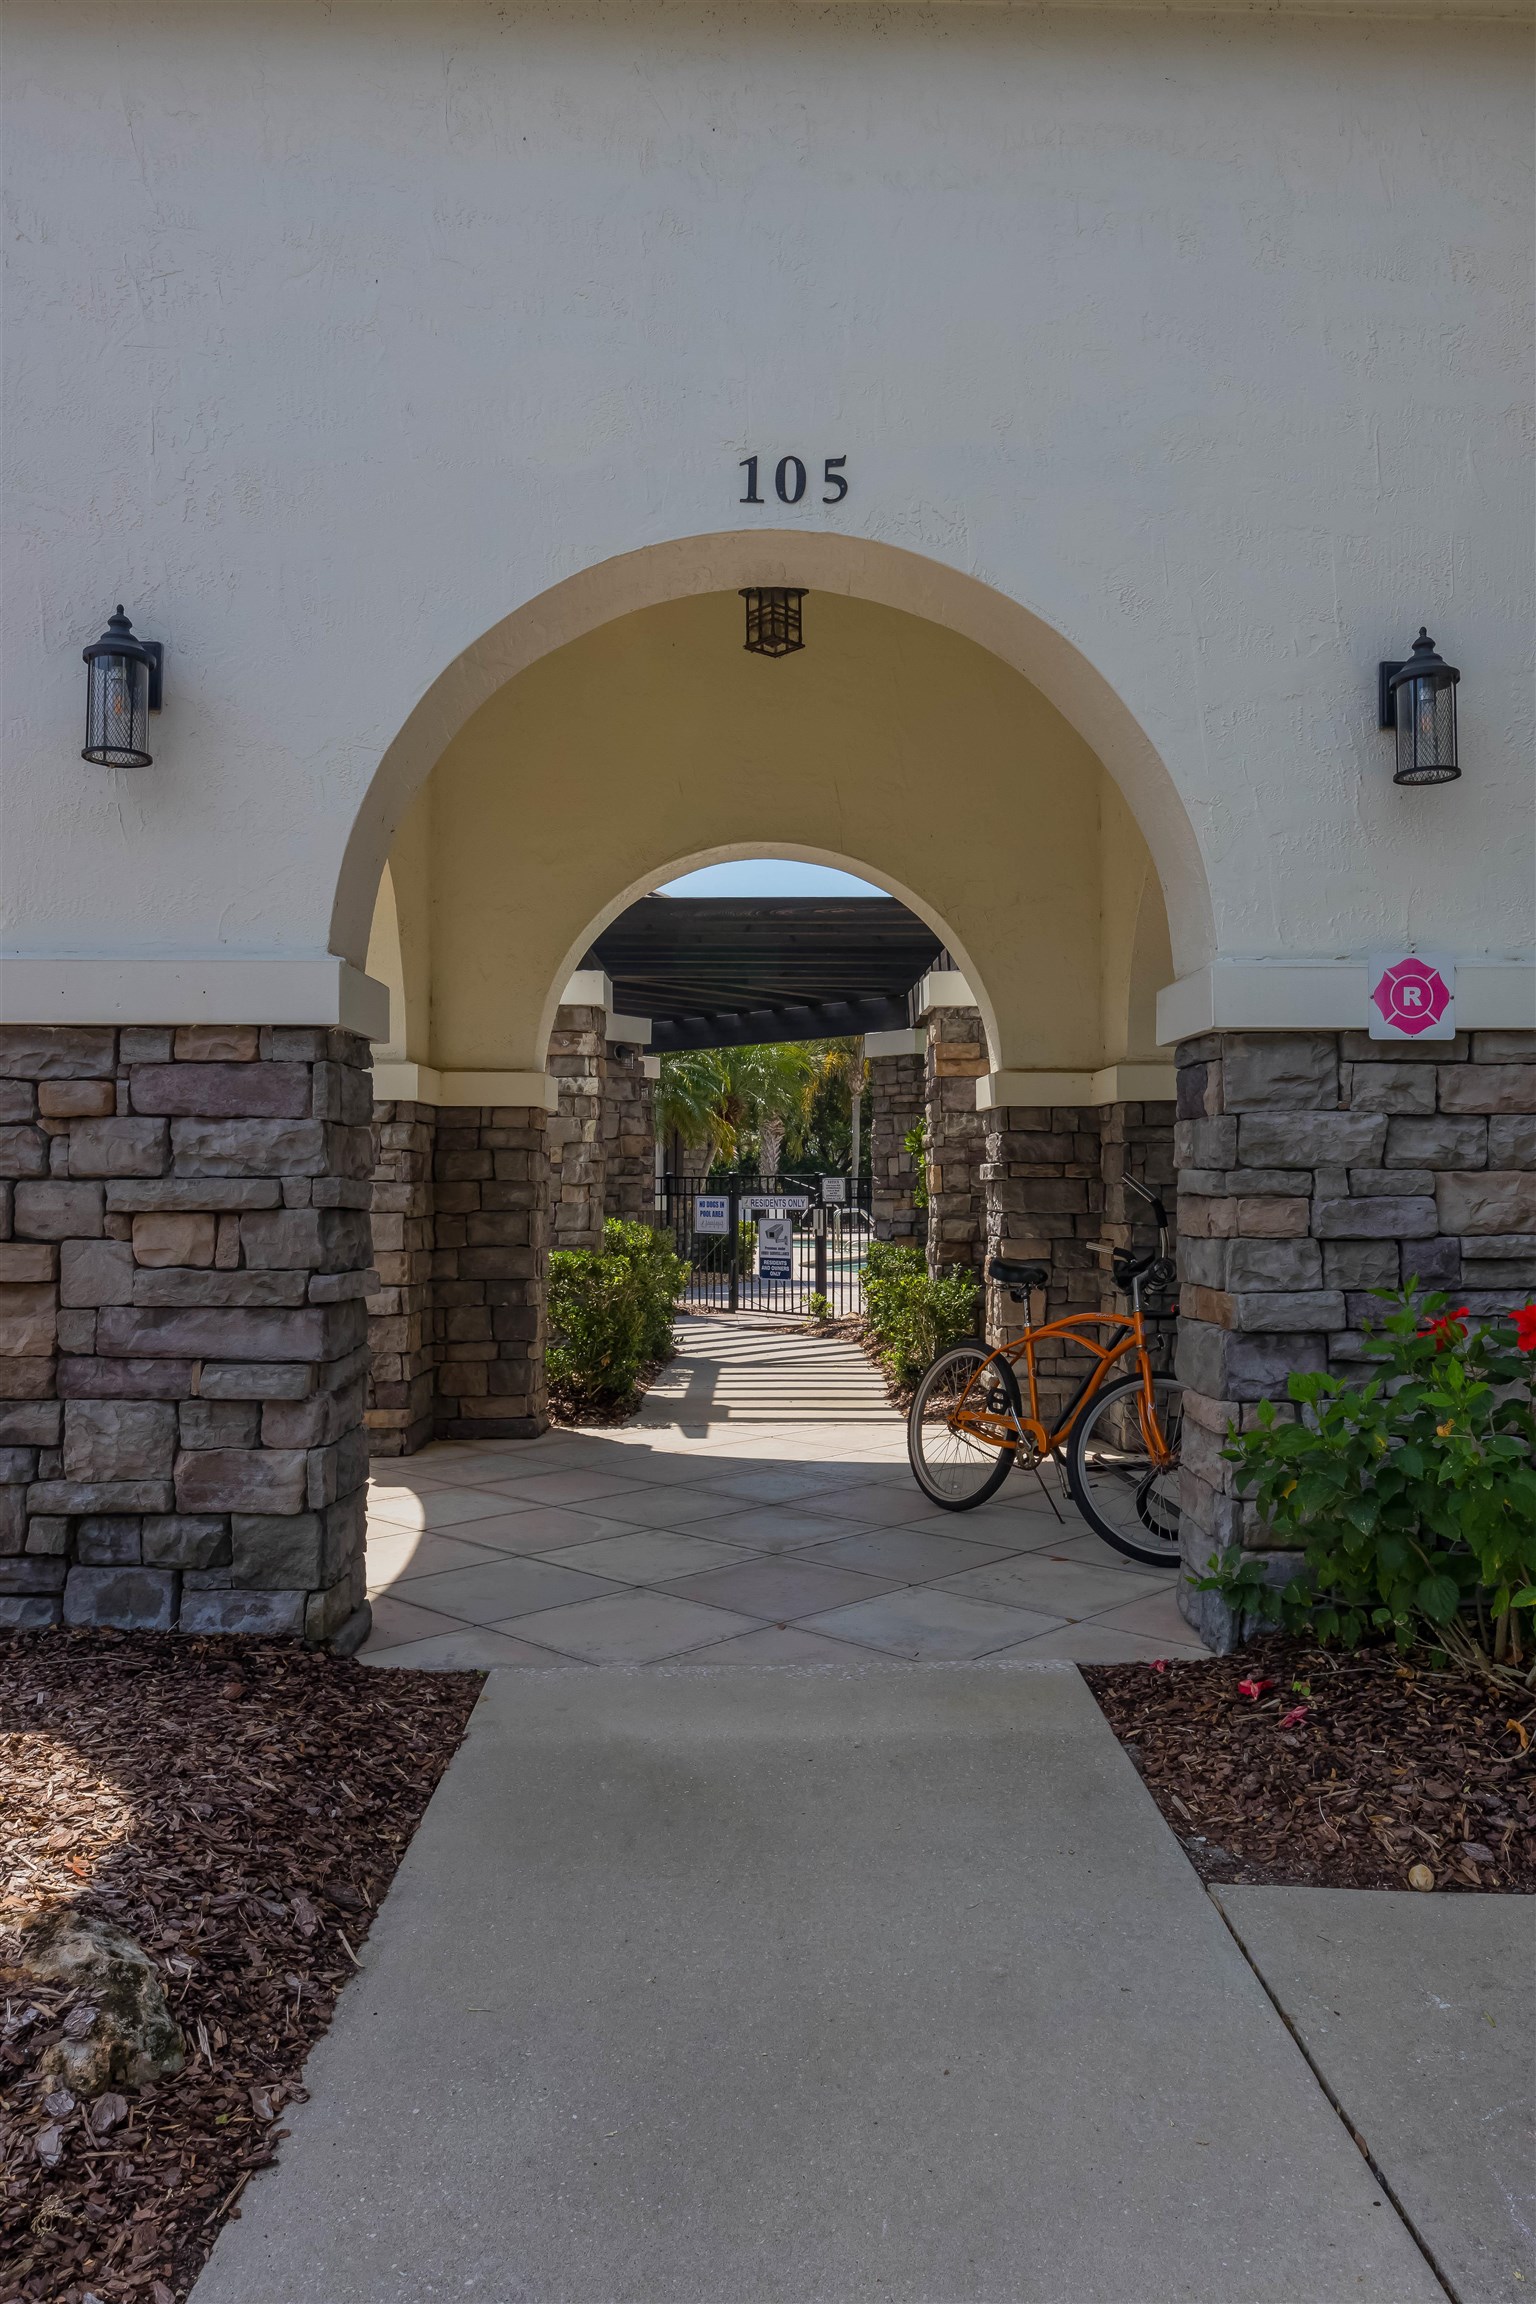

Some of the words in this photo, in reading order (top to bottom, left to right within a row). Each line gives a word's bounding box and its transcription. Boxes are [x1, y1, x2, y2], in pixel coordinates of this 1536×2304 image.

[739, 454, 849, 505] 105
[1403, 986, 1423, 1007] R
[750, 1199, 786, 1208] RESIDENTS
[788, 1199, 806, 1208] ONLY
